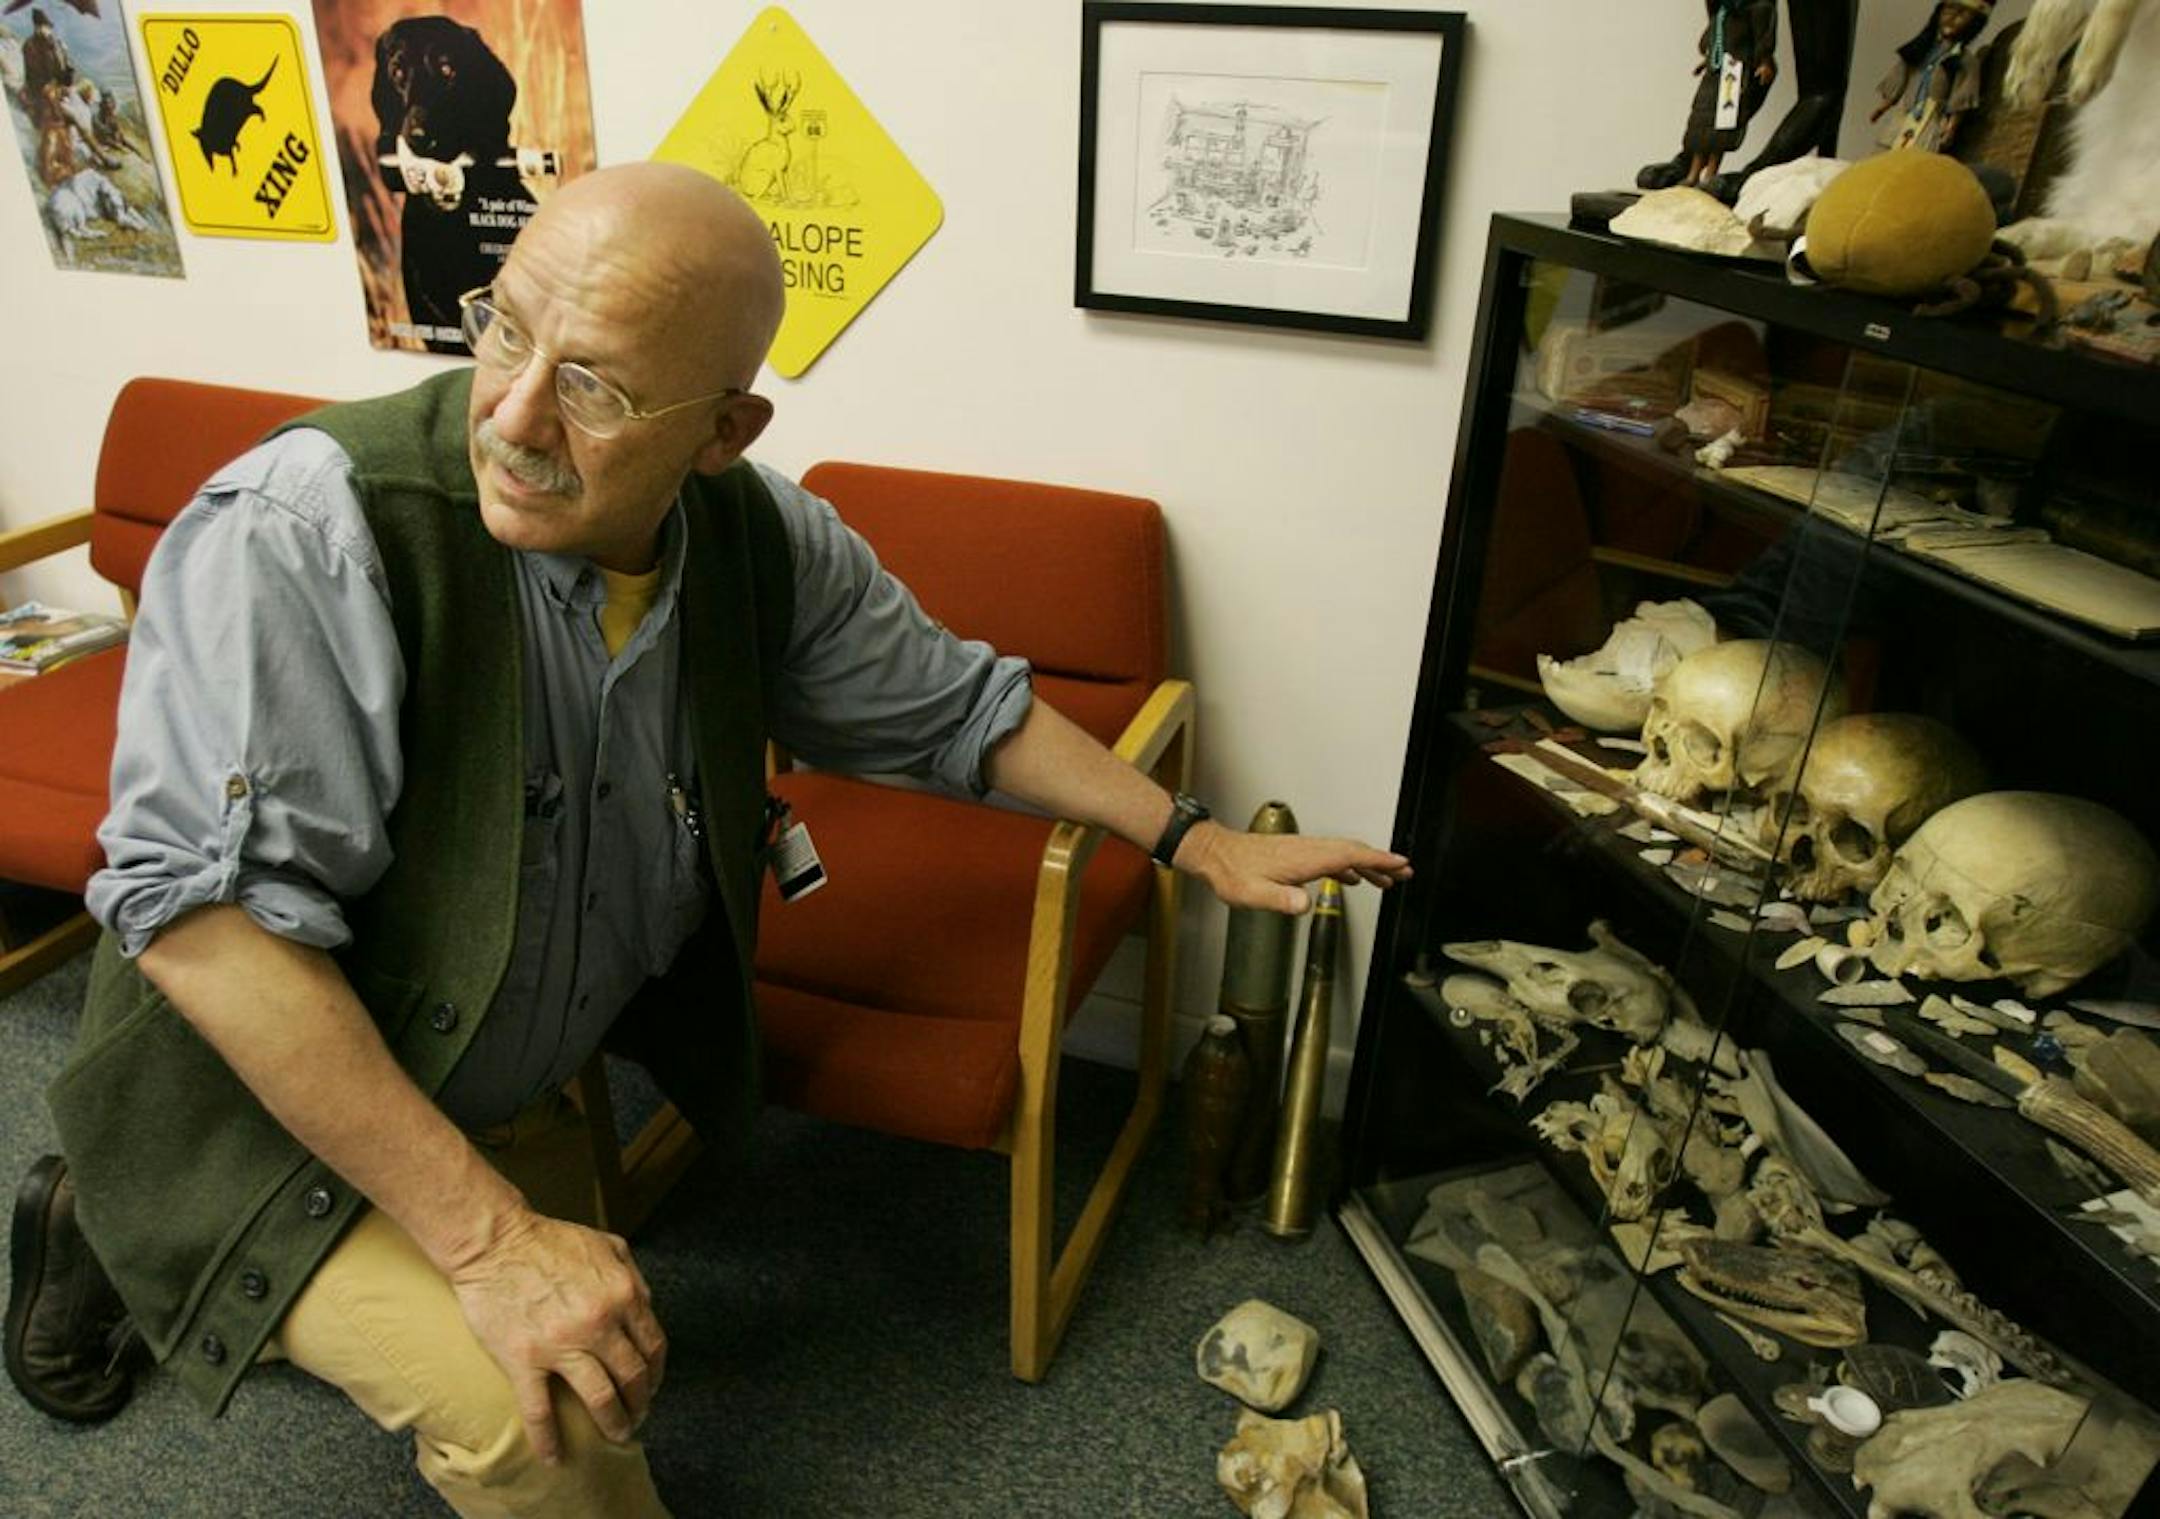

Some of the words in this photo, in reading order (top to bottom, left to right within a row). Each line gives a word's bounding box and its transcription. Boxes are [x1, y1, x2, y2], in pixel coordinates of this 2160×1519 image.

[254, 131, 310, 219] XING
[469, 212, 496, 228] BLACK
[782, 259, 844, 292] SING
